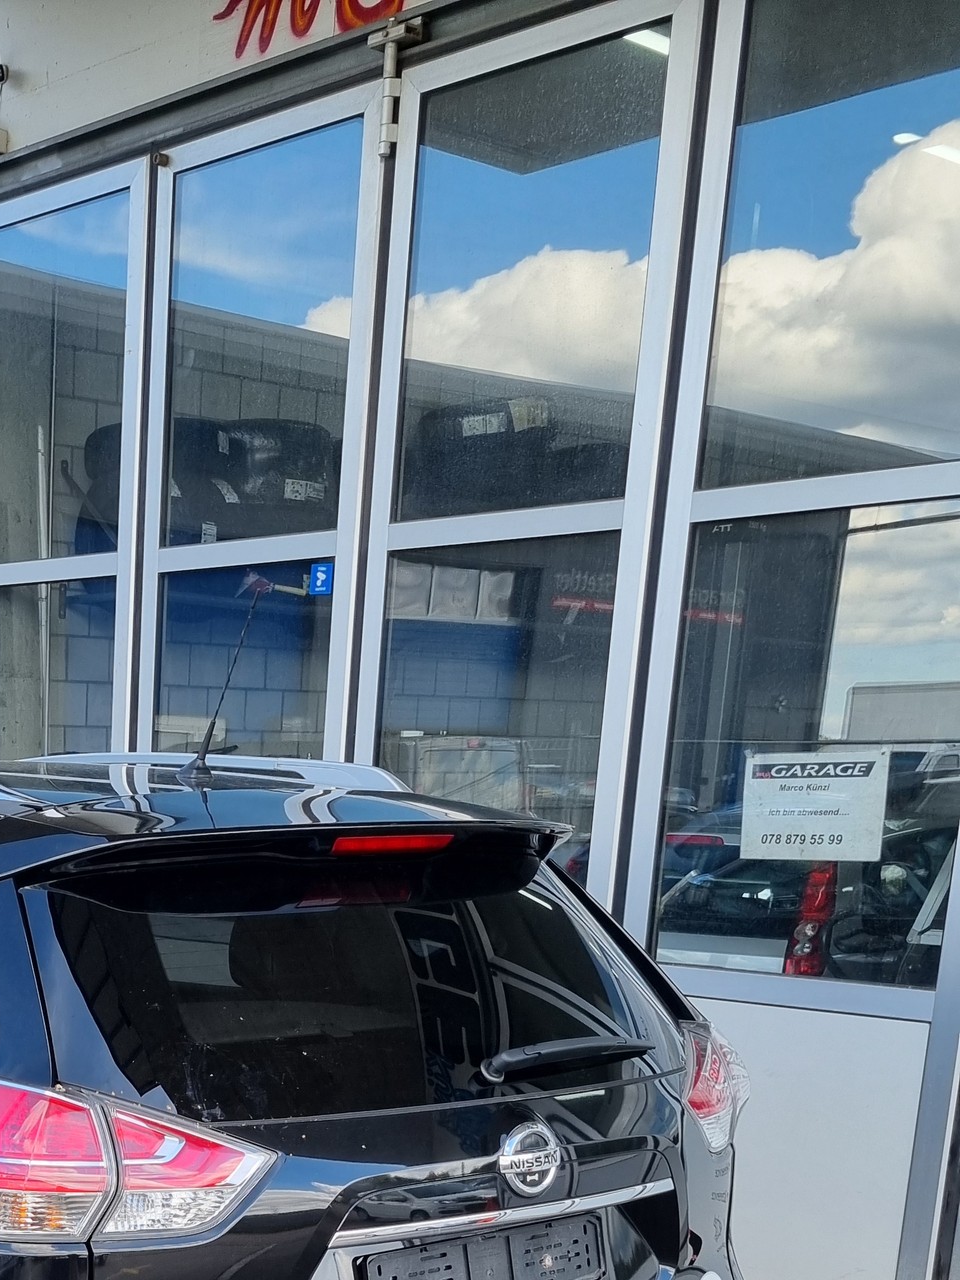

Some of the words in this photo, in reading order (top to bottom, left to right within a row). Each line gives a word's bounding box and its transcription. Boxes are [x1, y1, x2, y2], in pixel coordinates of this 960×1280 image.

[770, 763, 868, 777] GARAGE
[779, 784, 803, 792] Marco
[761, 834, 782, 845] 078
[785, 834, 806, 845] 879
[809, 834, 824, 845] 55
[827, 834, 843, 845] 99
[510, 1152, 558, 1169] NISSAN
